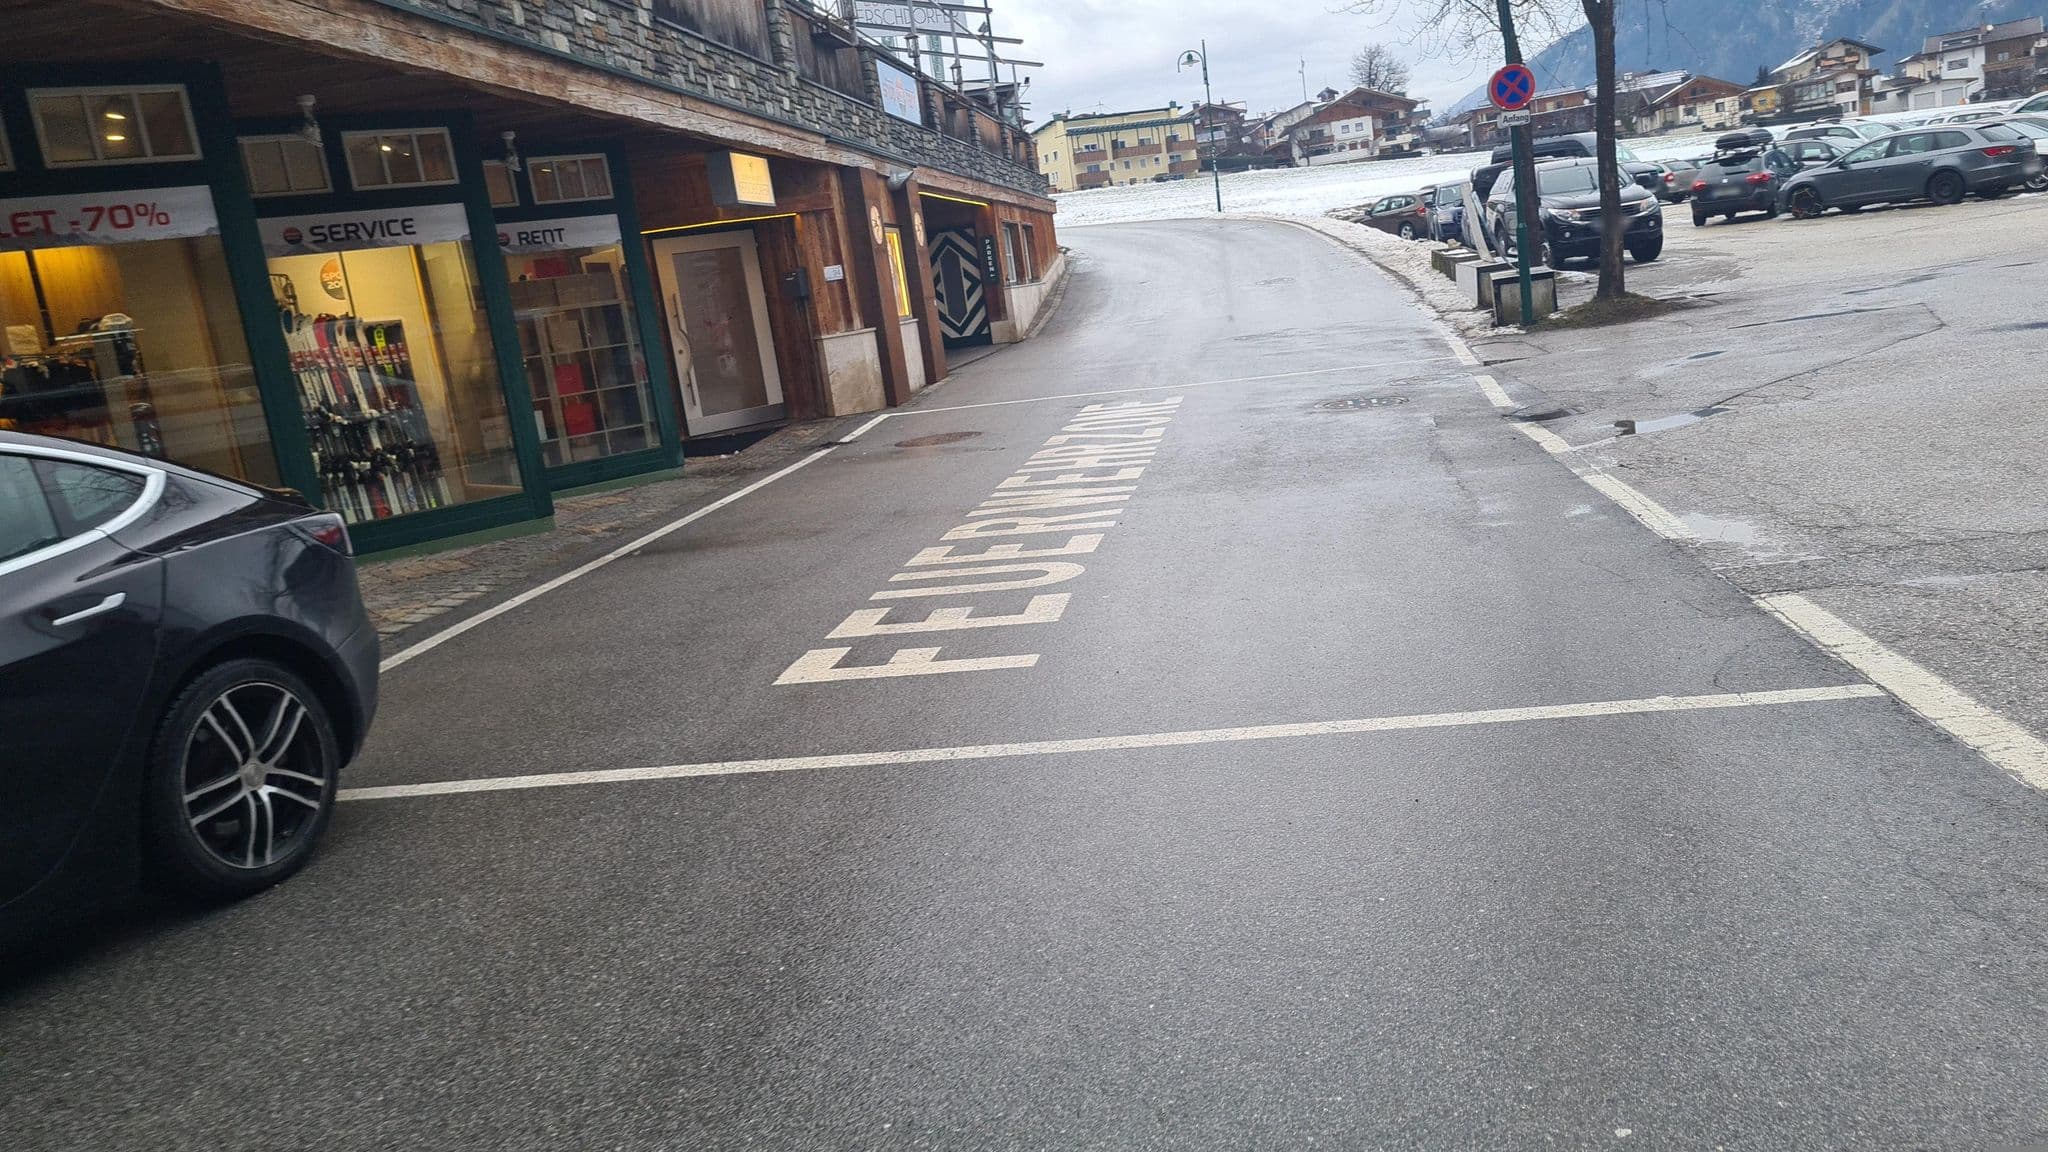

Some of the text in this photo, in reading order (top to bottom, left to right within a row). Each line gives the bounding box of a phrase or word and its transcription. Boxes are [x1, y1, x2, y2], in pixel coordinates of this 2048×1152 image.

[1502, 113, 1529, 124] Anfang
[68, 202, 171, 232] -70%
[309, 217, 417, 243] SERVICE
[517, 228, 565, 246] RENT
[984, 238, 996, 272] PARKEN
[772, 396, 1184, 686] FEUERWEHRZONE
